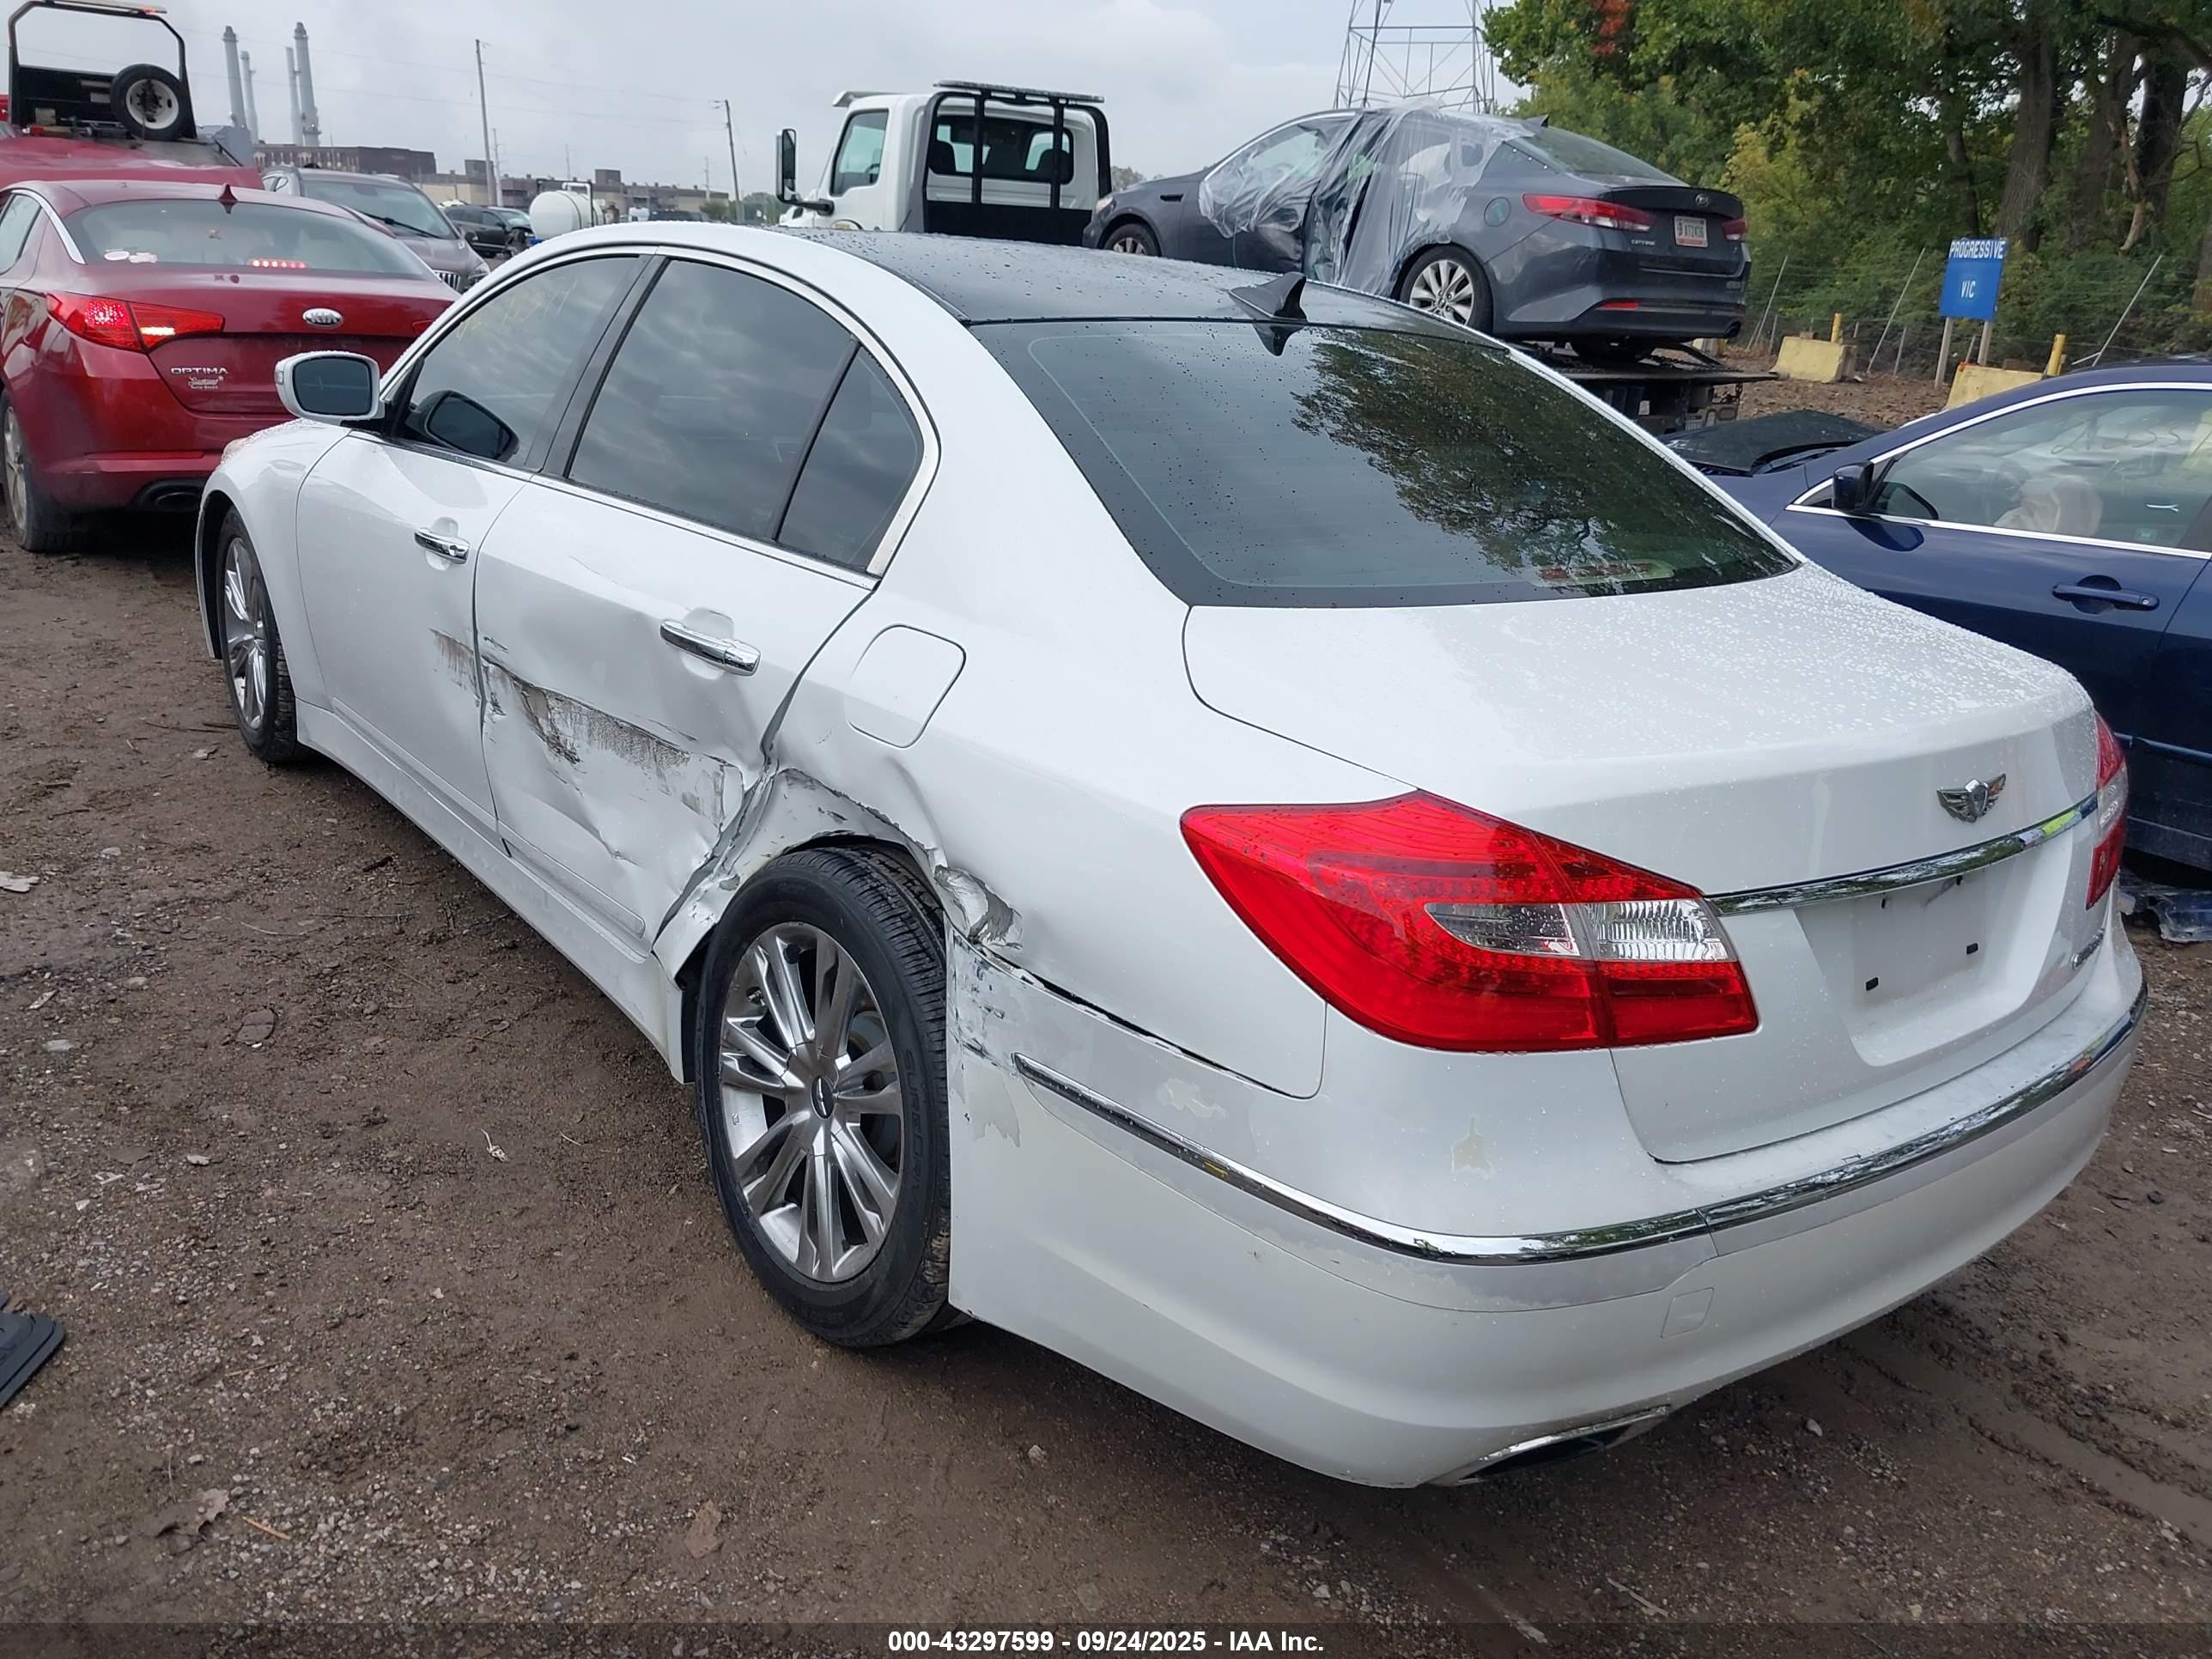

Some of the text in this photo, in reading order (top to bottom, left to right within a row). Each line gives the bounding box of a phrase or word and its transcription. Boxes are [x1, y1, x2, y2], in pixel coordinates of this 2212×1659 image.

[1948, 240, 2007, 259] PROGRESSIVE
[1960, 280, 1977, 299] VIC
[170, 367, 229, 376] OPTIMA
